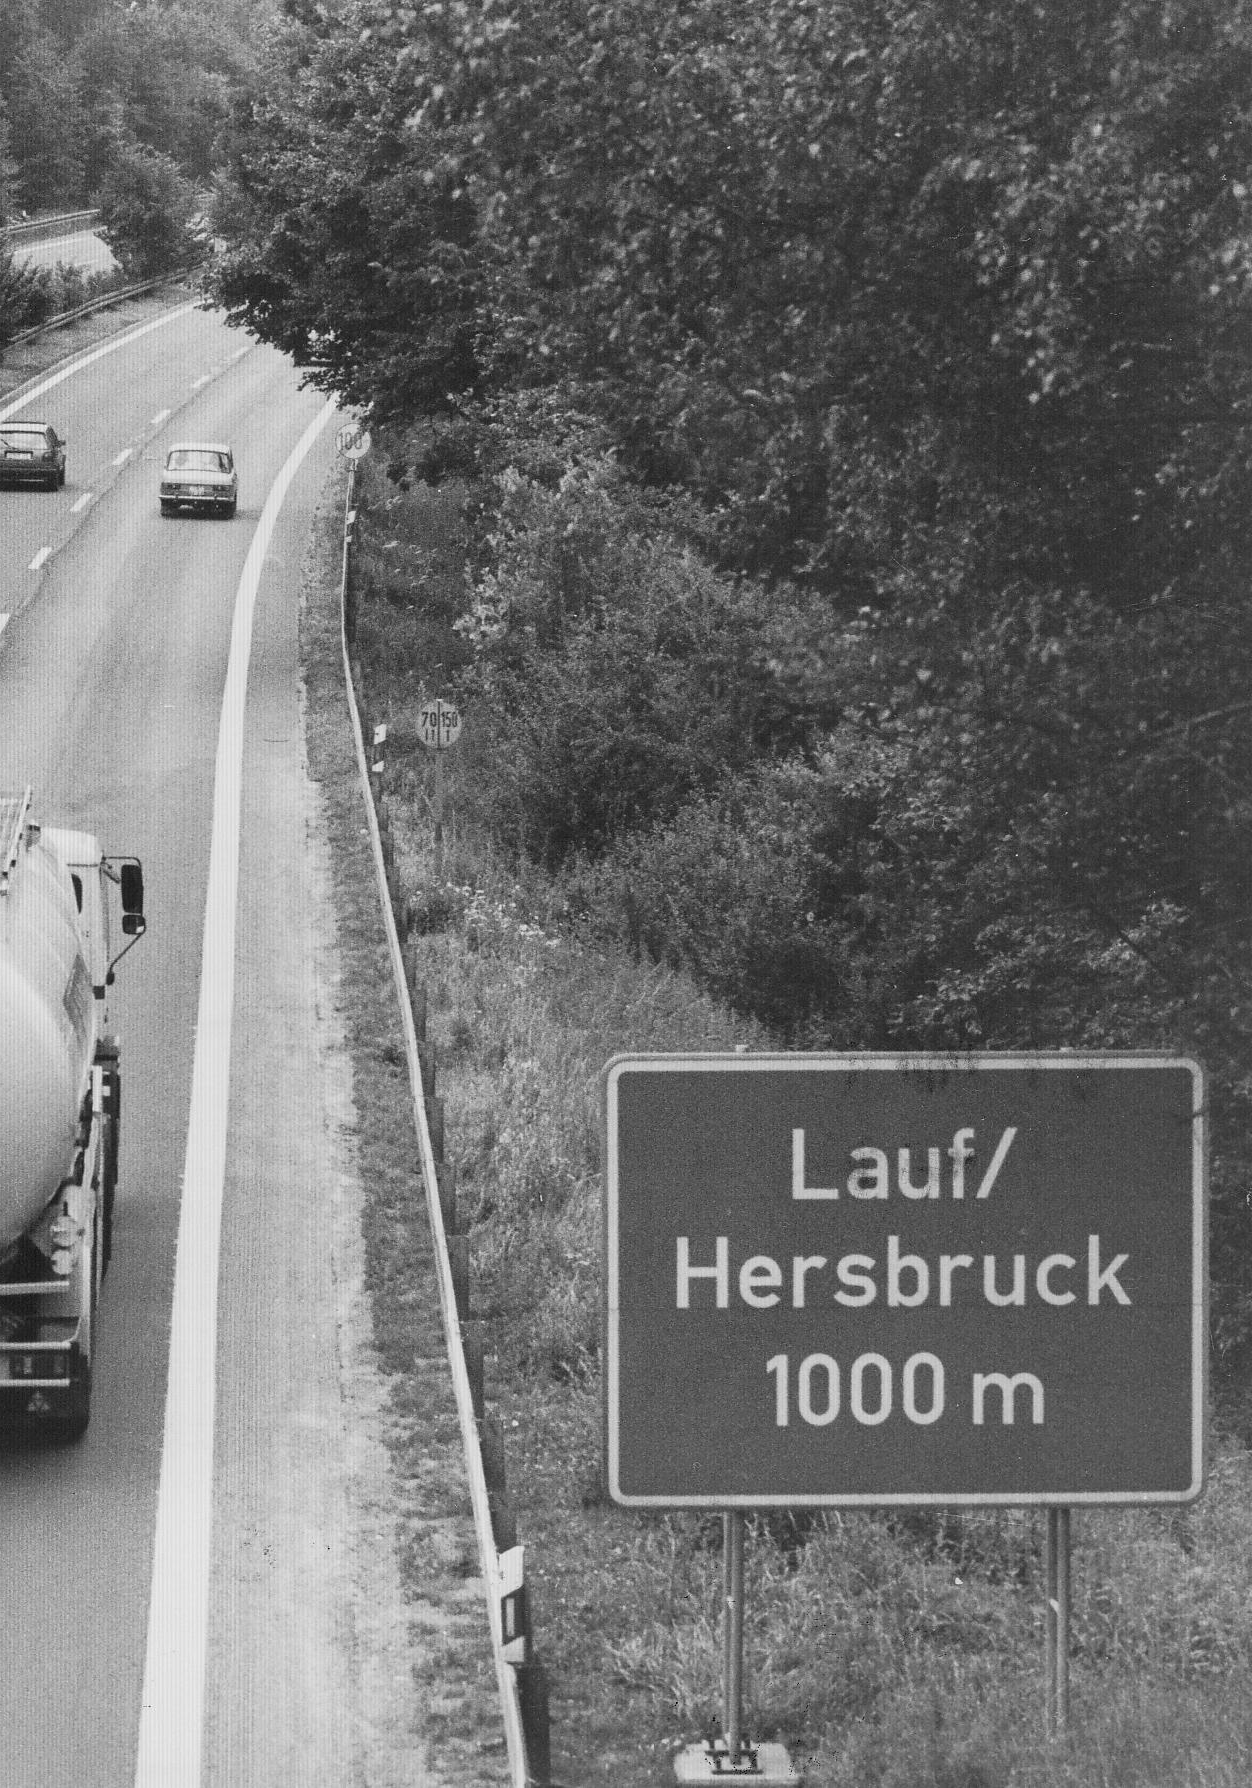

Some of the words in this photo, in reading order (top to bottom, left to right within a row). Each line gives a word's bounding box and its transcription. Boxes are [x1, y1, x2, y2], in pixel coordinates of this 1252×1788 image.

[422, 711, 437, 727] 70
[791, 1127, 1018, 1200] Lauf/
[675, 1234, 1132, 1308] Hersbruck
[766, 1353, 945, 1426] 1000
[972, 1370, 1045, 1425] m
